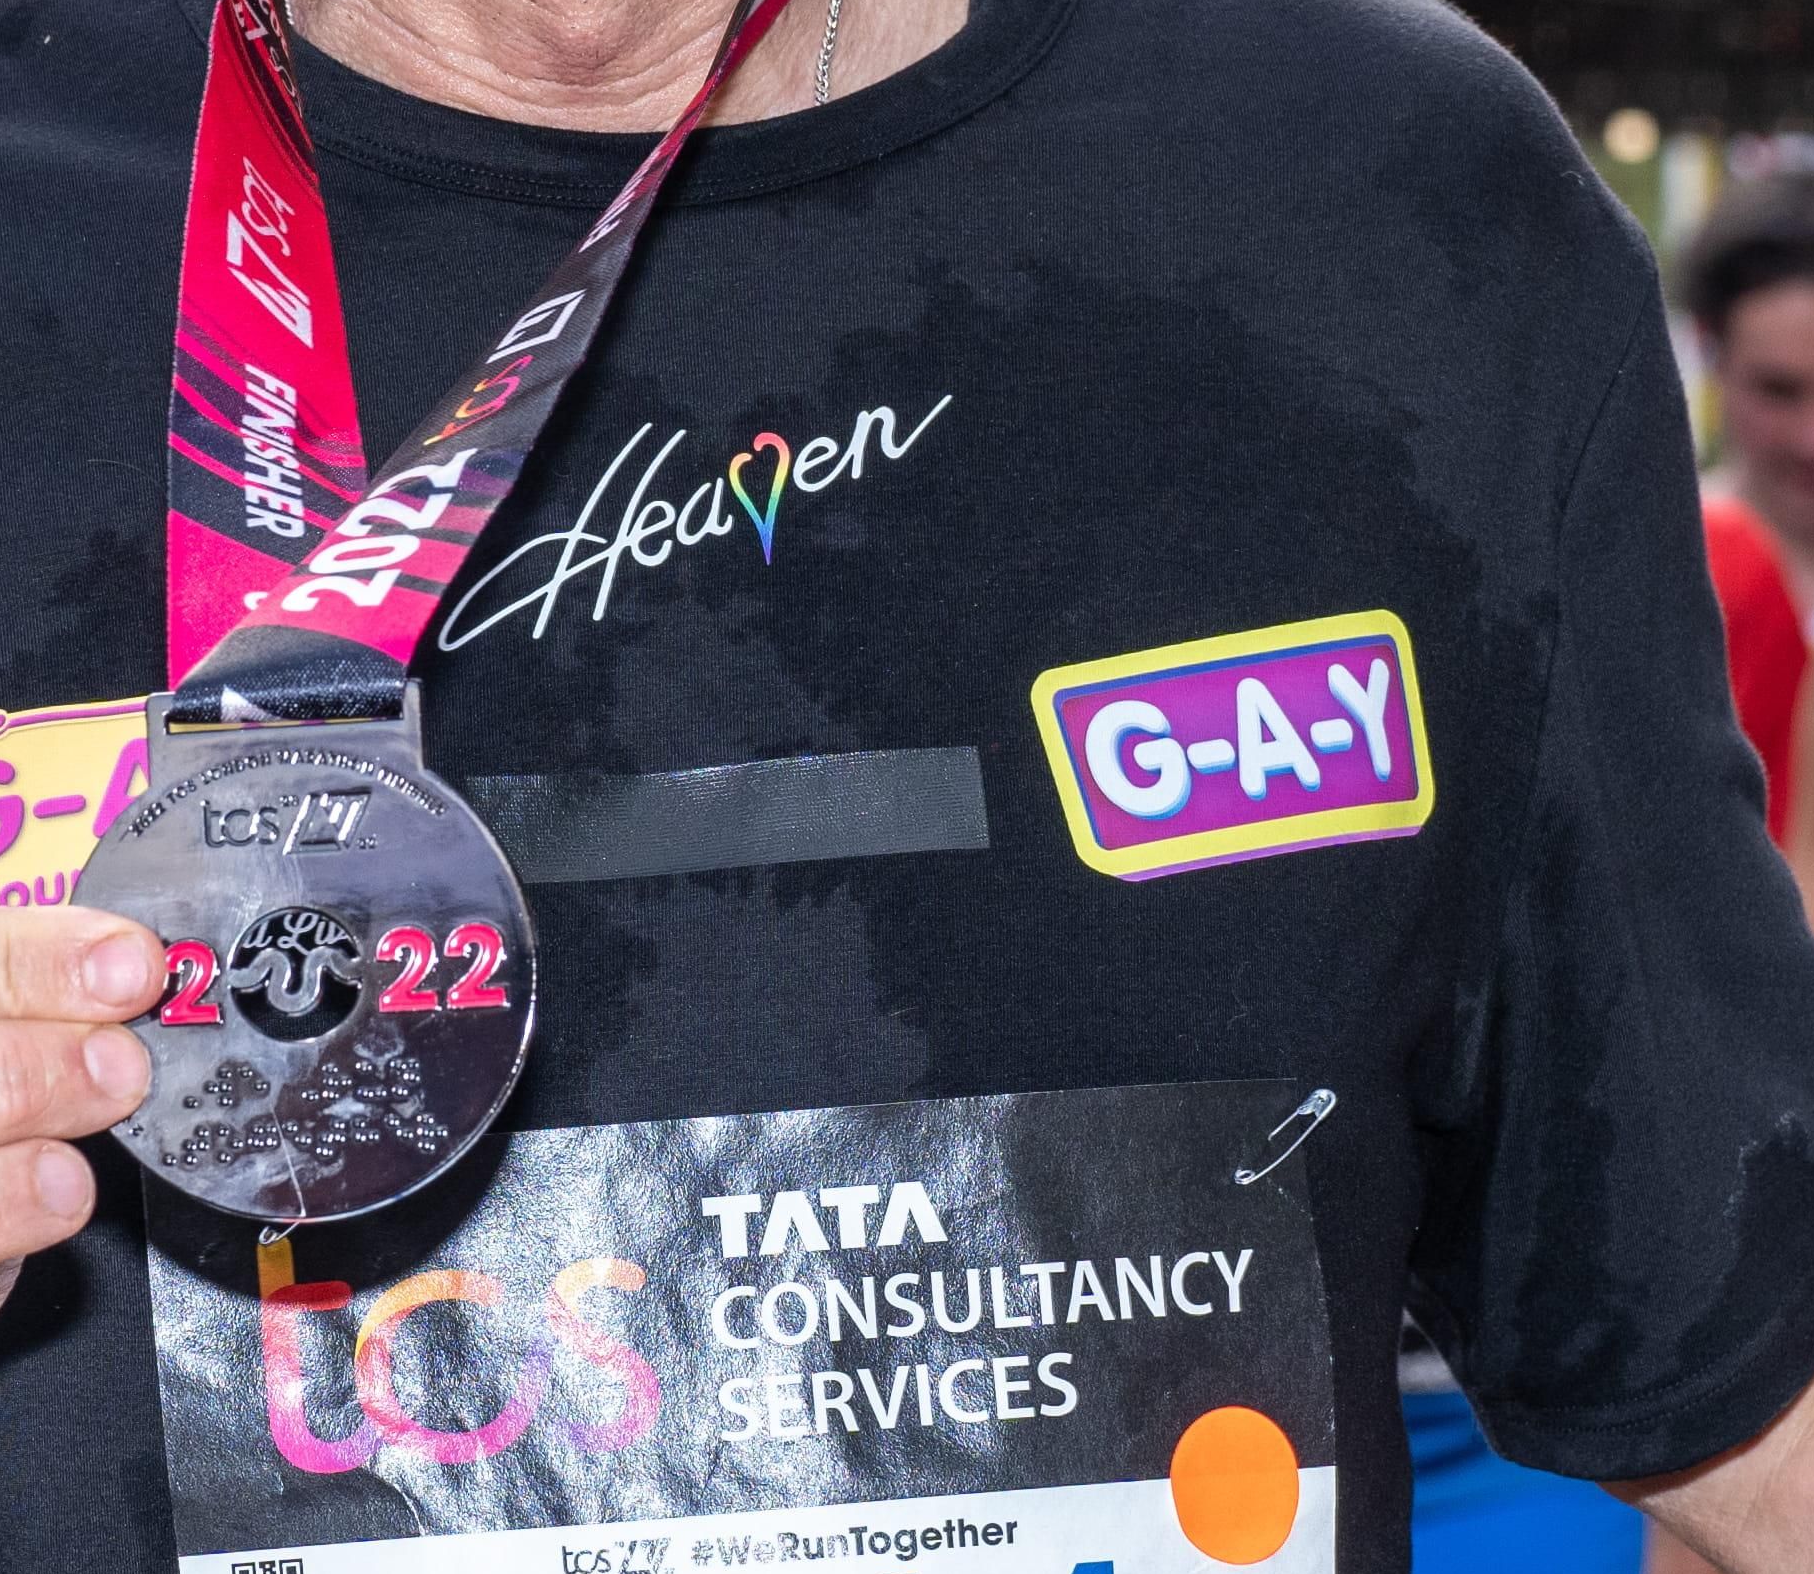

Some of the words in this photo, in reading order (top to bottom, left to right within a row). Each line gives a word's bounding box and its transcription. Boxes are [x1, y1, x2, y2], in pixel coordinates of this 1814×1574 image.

[244, 363, 308, 539] FINISHER
[281, 447, 469, 617] 2022
[438, 393, 953, 652] Heaven
[1085, 658, 1392, 820] G-A-Y
[202, 799, 279, 848] tcs
[701, 1181, 948, 1259] TATA
[255, 1235, 662, 1474] tcs
[711, 1247, 1254, 1352] CONSULTANCY
[717, 1352, 1079, 1442] SERVICES
[690, 1518, 1019, 1567] #WeRunTogether
